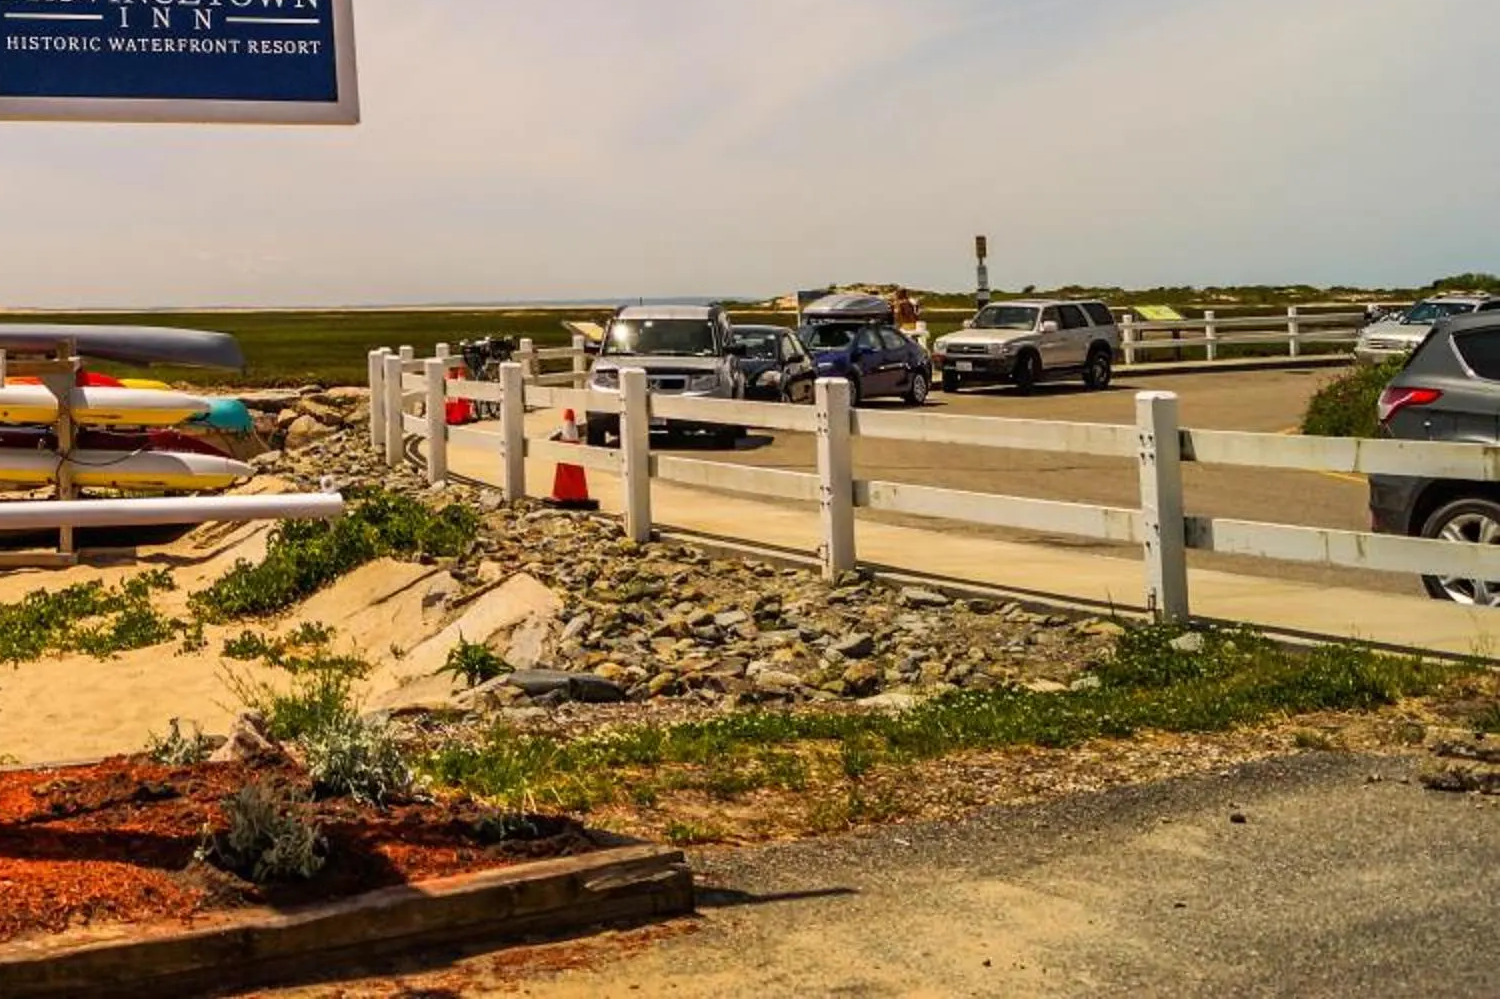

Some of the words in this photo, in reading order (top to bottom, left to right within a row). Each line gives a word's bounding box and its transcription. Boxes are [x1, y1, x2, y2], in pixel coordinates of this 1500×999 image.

[119, 6, 212, 30] INN
[6, 36, 101, 51] HISTORIC
[108, 38, 240, 54] WATERFRONT
[248, 40, 322, 55] RESORT
